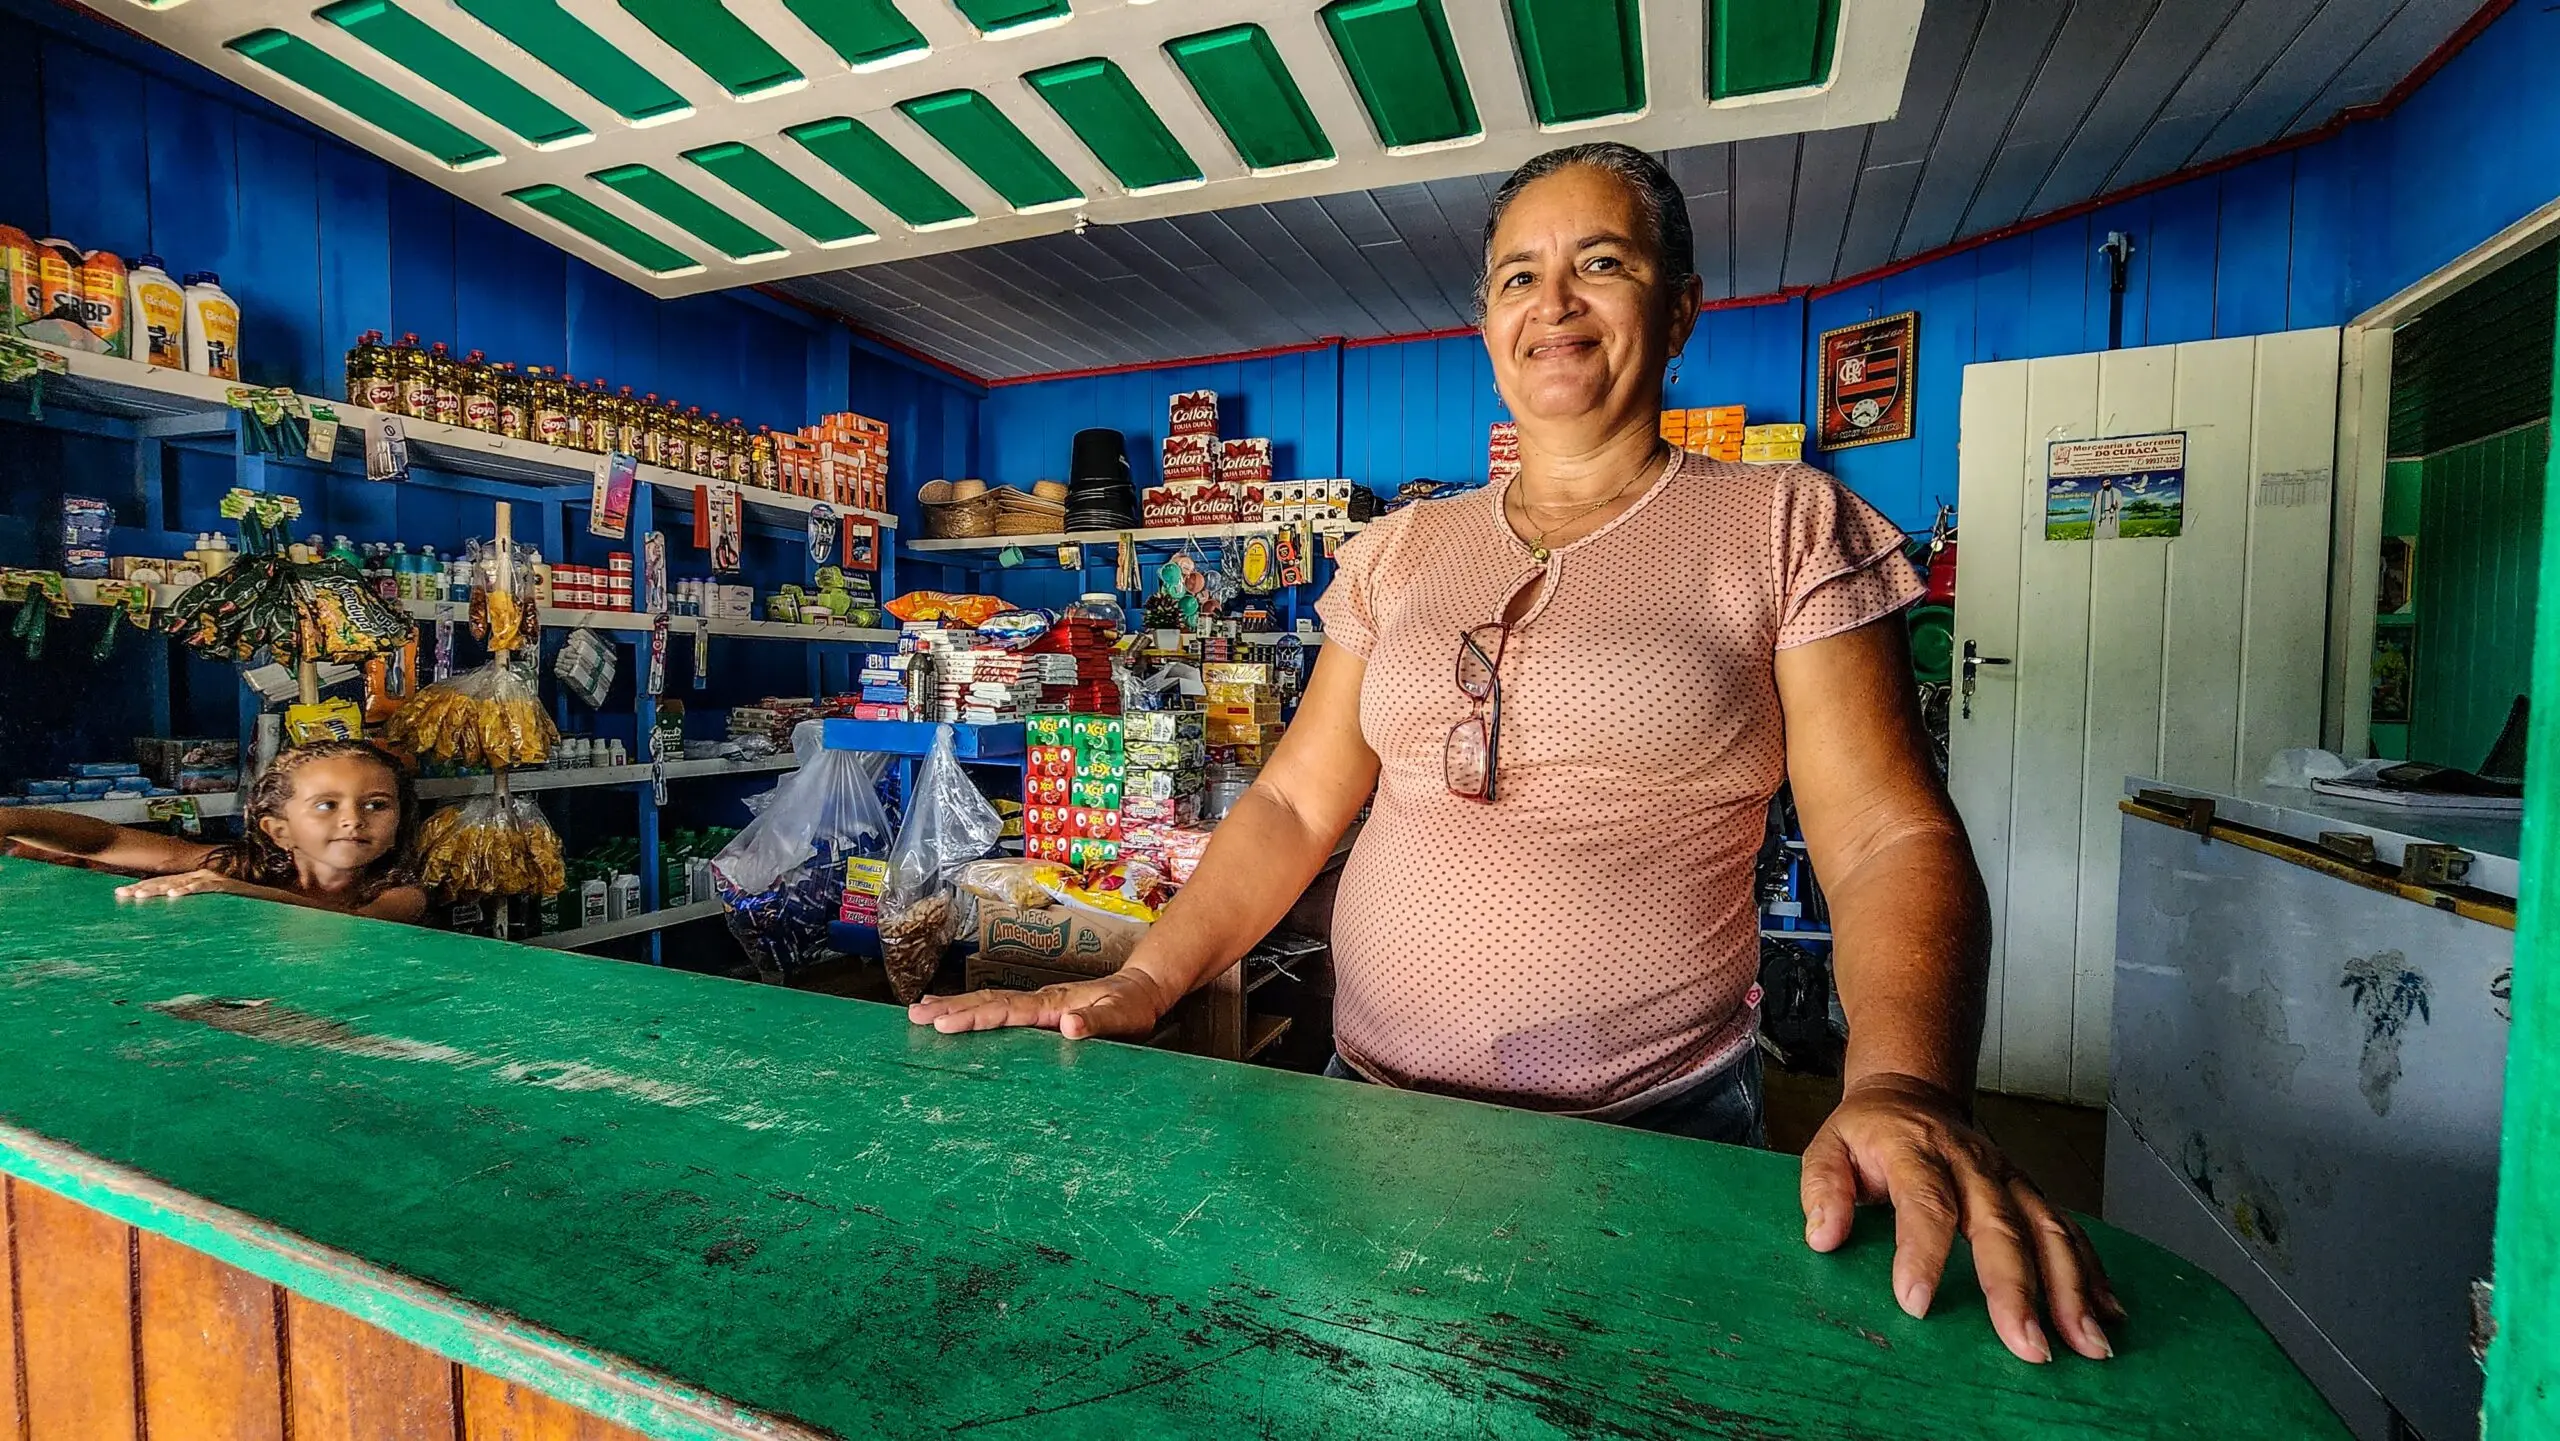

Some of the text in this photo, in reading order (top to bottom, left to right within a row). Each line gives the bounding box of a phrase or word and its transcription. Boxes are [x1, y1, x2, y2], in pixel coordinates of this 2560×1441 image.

[372, 388, 395, 400] Soy
[436, 400, 458, 410] oya
[469, 405, 495, 418] Soya
[1173, 407, 1213, 424] Cotton
[542, 420, 567, 430] Soya
[1193, 420, 1212, 429] DUPLA
[2073, 441, 2123, 452] Mercearia
[1163, 452, 1201, 469] Cotton
[1222, 455, 1261, 471] Cotton
[1180, 465, 1200, 473] DUPLA
[1144, 504, 1187, 518] Cotton
[1191, 500, 1234, 514] Cotton
[1212, 513, 1232, 521] DUPLA
[1016, 908, 1053, 926] Snacks
[994, 919, 1062, 954] Amendupá
[1081, 930, 1094, 941] 30
